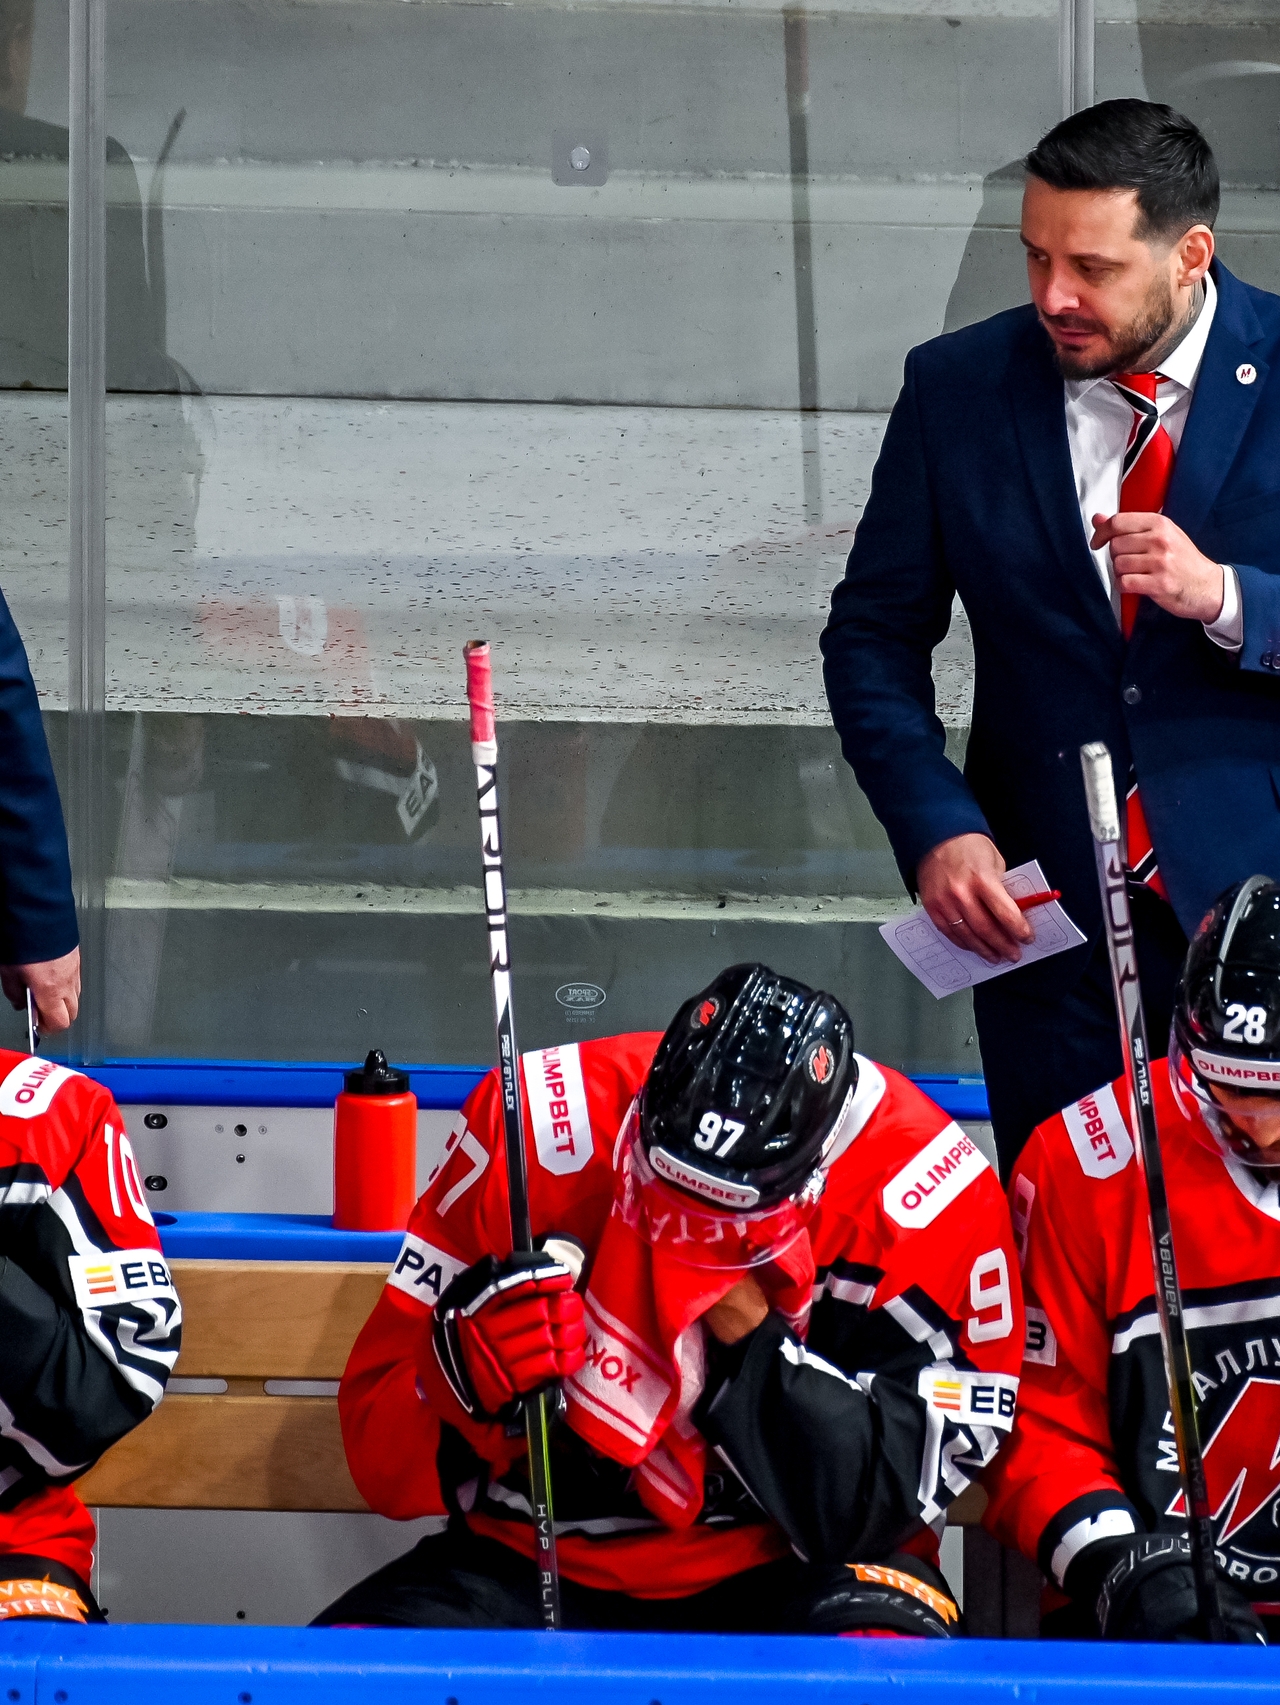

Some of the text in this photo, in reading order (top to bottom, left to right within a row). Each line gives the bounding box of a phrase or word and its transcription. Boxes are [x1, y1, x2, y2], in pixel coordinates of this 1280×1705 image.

[1223, 1004, 1268, 1044] 28
[694, 1111, 746, 1159] 97
[104, 1123, 155, 1227] 10
[654, 1156, 751, 1203] OLIMPBET
[394, 1247, 447, 1298] РА
[968, 1248, 1013, 1344] 9
